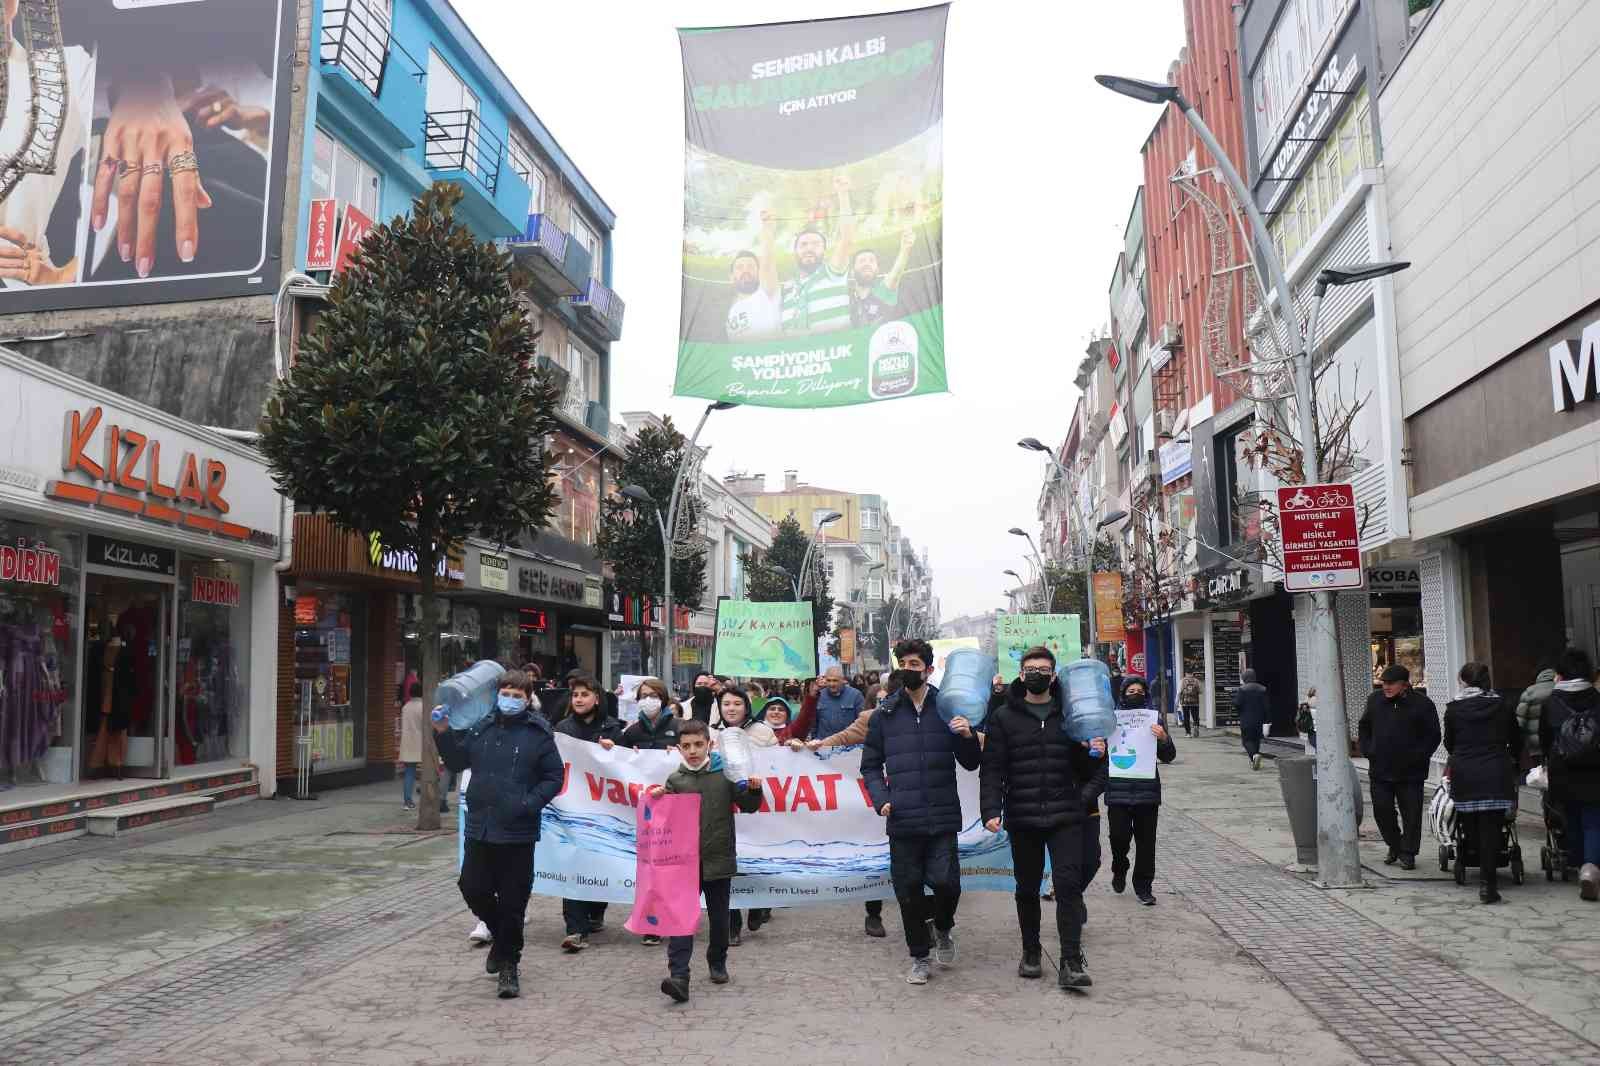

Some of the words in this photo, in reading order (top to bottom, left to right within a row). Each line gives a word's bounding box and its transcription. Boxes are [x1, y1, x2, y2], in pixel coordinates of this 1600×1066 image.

[808, 89, 857, 110] ATIYOR
[1307, 54, 1340, 125] SPOR
[347, 216, 364, 244] YA
[752, 362, 832, 381] YOLUNDA
[64, 406, 230, 514] KIZLAR
[104, 543, 160, 569] KIZLAR
[533, 869, 567, 883] naokulu
[769, 886, 787, 895] Fen
